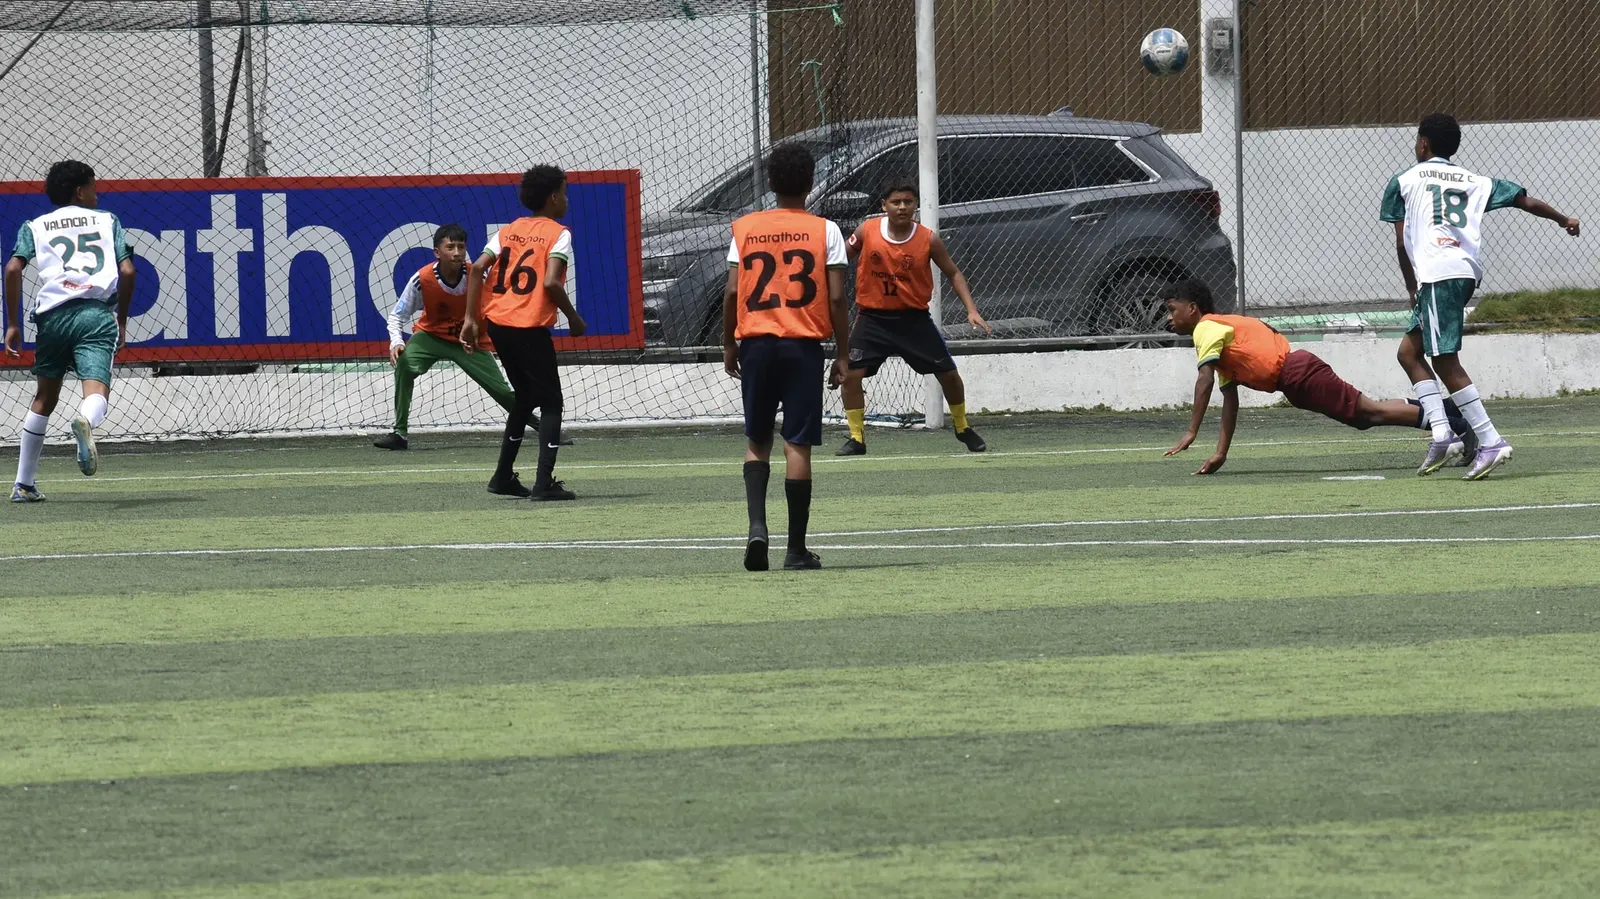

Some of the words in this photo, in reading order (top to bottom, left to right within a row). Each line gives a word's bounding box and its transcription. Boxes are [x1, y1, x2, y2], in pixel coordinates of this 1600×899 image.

[43, 217, 88, 231] VALENCIA
[1426, 184, 1469, 229] 18
[48, 231, 105, 276] 25
[746, 231, 810, 245] marathon
[492, 246, 538, 296] 16
[742, 249, 817, 312] 23
[883, 281, 899, 297] 12
